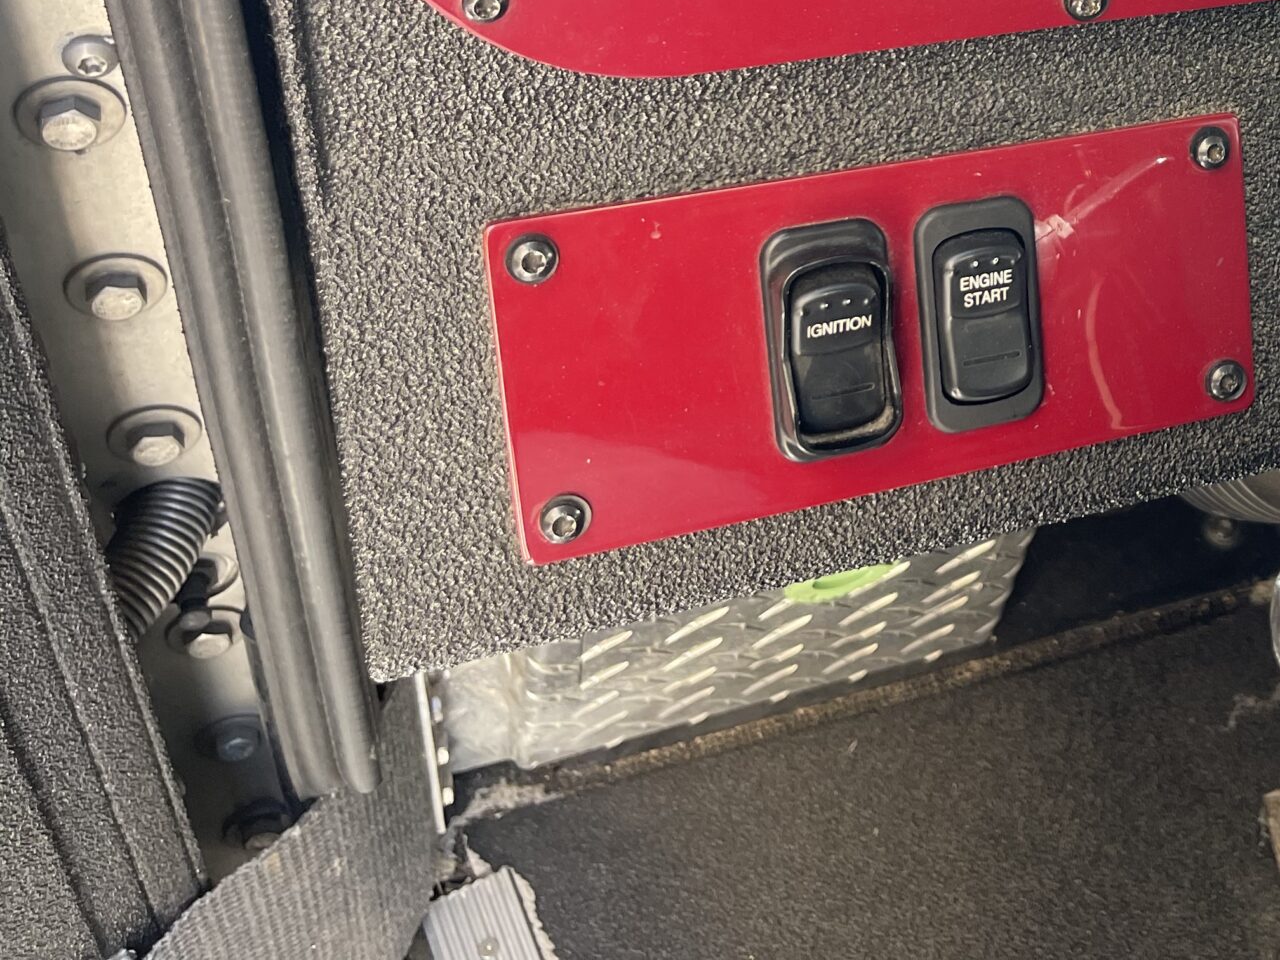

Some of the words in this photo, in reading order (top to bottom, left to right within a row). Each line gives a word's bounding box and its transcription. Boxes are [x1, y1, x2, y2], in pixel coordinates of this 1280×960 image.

[959, 269, 1013, 292] ENGINE
[963, 287, 1009, 308] START
[807, 314, 872, 339] IGNITION
